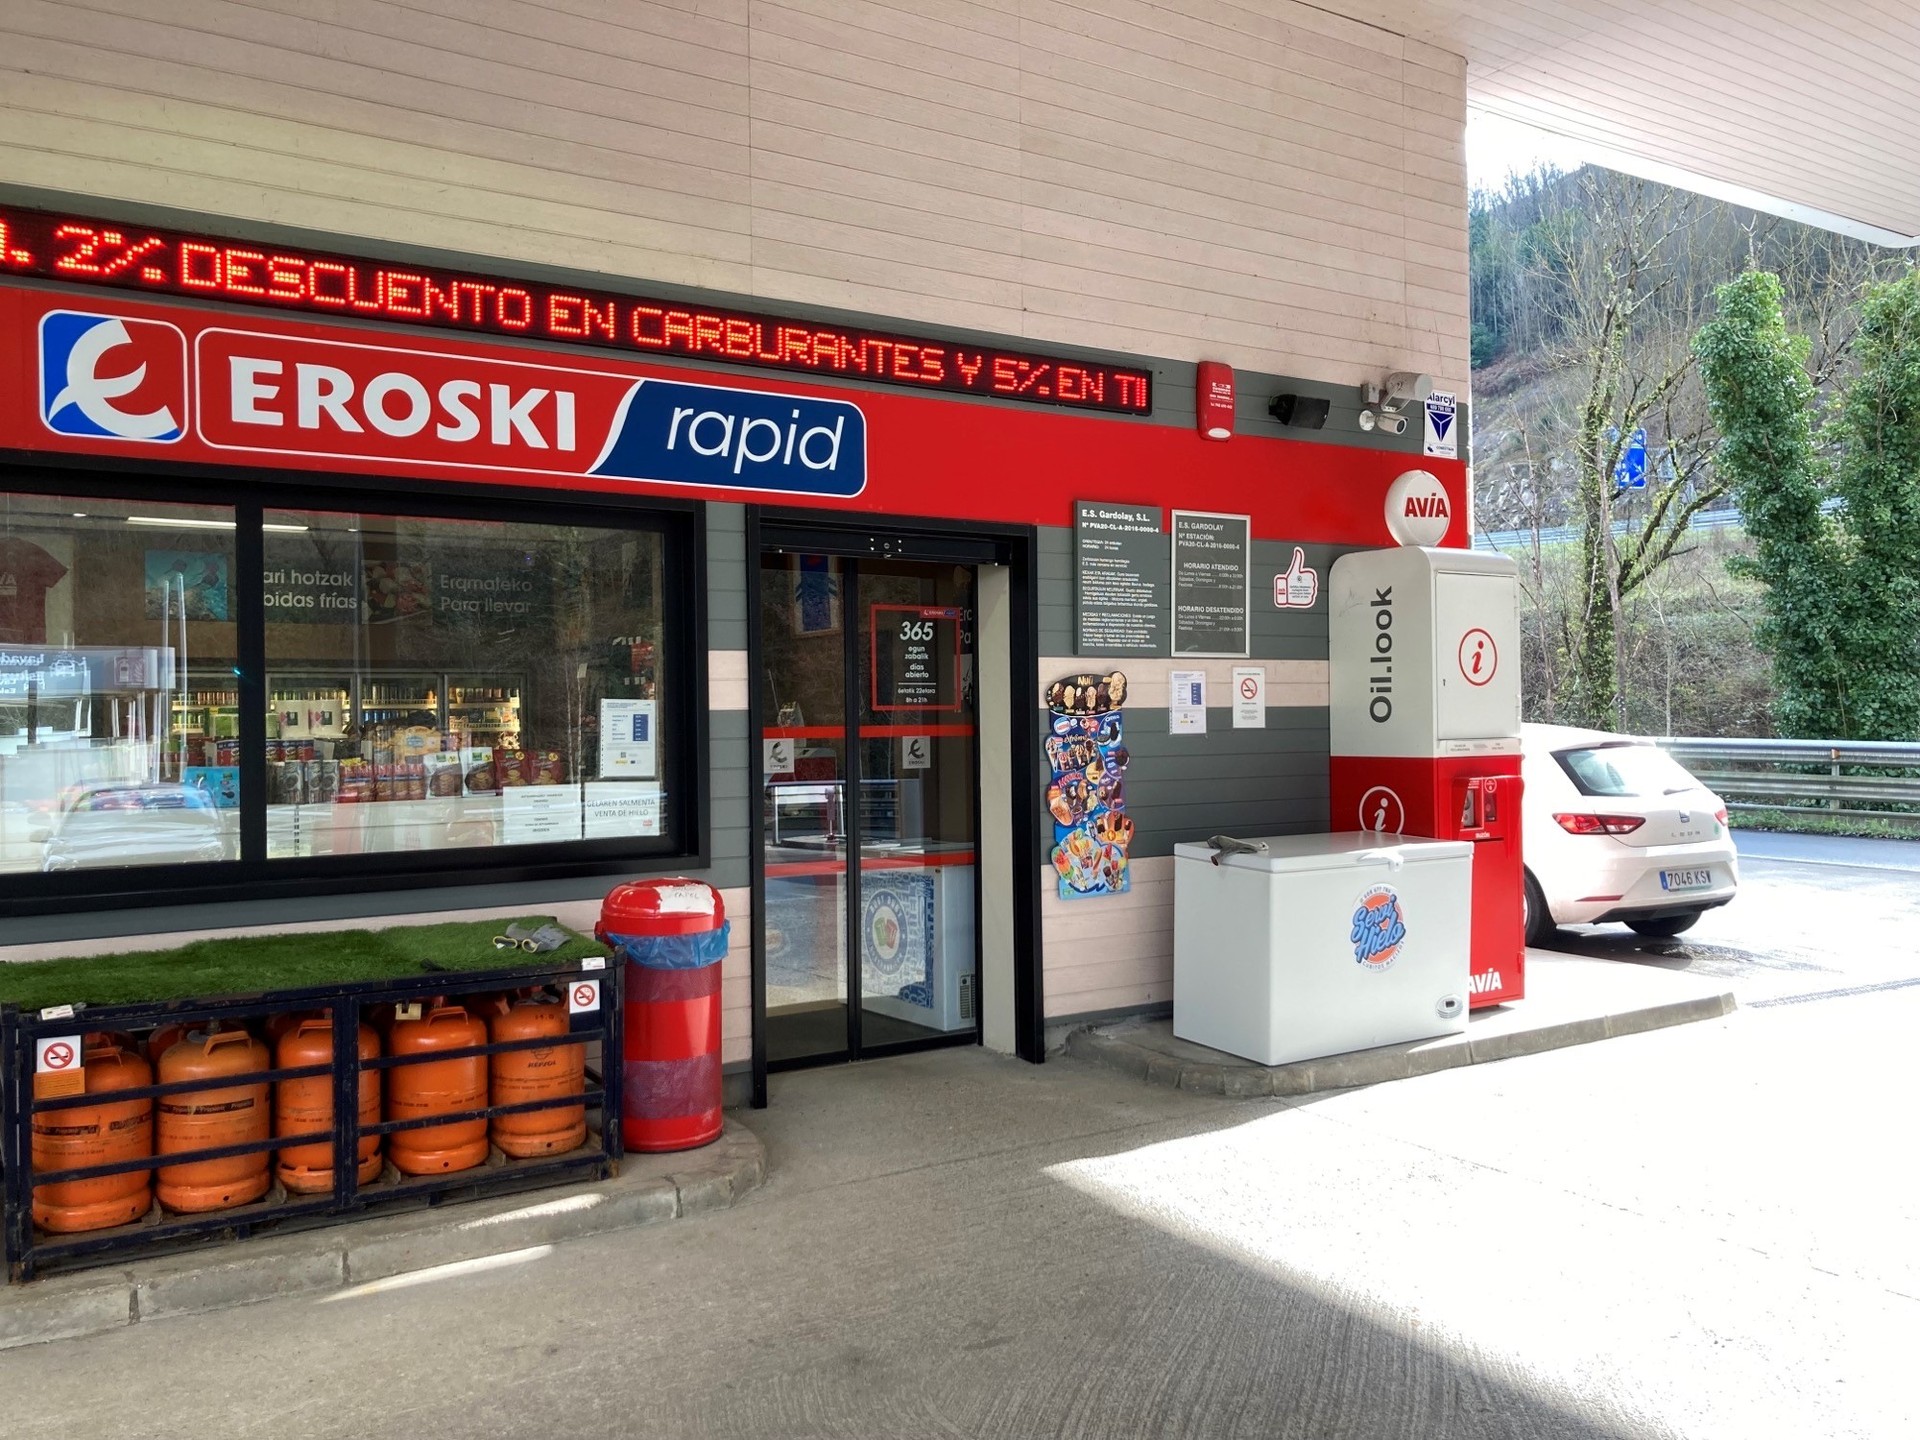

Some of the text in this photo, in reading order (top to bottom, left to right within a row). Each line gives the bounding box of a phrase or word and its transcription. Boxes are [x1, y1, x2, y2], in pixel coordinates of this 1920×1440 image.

[55, 224, 167, 282] 2%
[180, 243, 531, 328] DESCUENTO
[549, 294, 615, 339] EN
[632, 306, 945, 384] CARBURANTES
[958, 352, 982, 385] Y
[994, 358, 1049, 397] 5%
[1057, 367, 1104, 402] EN
[228, 355, 844, 474] EROSKI rapid
[1082, 509, 1097, 518] E.S.
[1136, 513, 1150, 522] S.L.
[1191, 523, 1224, 531] GARDOLAY
[1184, 562, 1210, 570] HORARIO
[291, 568, 353, 588] hotzak
[441, 575, 533, 592] Eramateko
[319, 591, 357, 609] frías
[441, 597, 531, 613] Para llevar
[899, 621, 933, 641] 365
[908, 647, 925, 655] egun
[1369, 585, 1393, 724] Oil.look
[909, 662, 924, 670] días
[1667, 872, 1693, 887] 7046
[1357, 910, 1406, 963] Hielo
